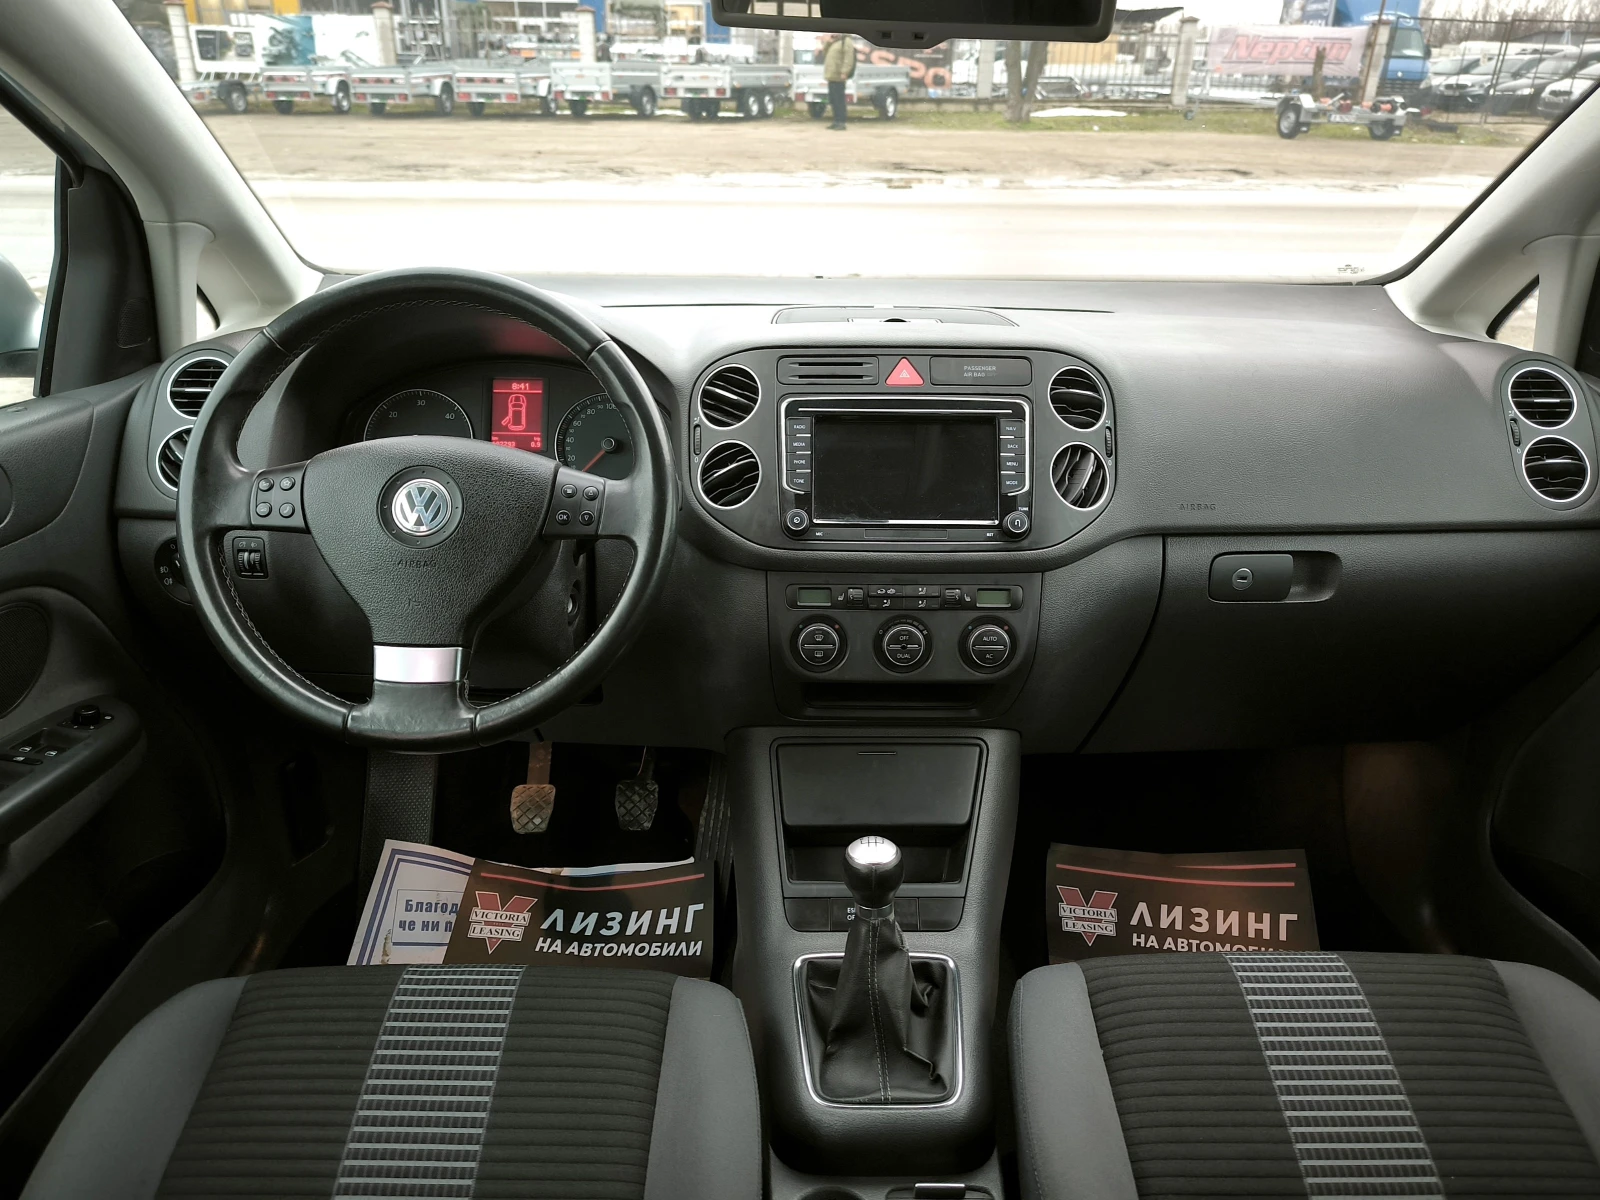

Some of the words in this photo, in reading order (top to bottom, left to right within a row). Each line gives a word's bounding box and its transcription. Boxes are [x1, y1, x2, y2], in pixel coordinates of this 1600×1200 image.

[1222, 34, 1352, 65] Neptun
[511, 382, 530, 390] 8:41
[444, 412, 455, 420] 40
[1179, 503, 1216, 511] AIRBAG
[398, 559, 437, 569] AIRBAG
[474, 910, 528, 922] VICTORIA
[1061, 906, 1115, 919] VICTORIA
[539, 903, 705, 936] ЛИЗИНГ
[1129, 901, 1298, 941] ЛИЗИНГ
[398, 920, 416, 933] че
[421, 920, 440, 933] ни
[471, 926, 521, 938] LEASING
[1065, 921, 1113, 933] LEASING
[534, 936, 562, 954] НА
[565, 940, 702, 957] АВТОМОБИЛИ
[1131, 933, 1159, 949] НА
